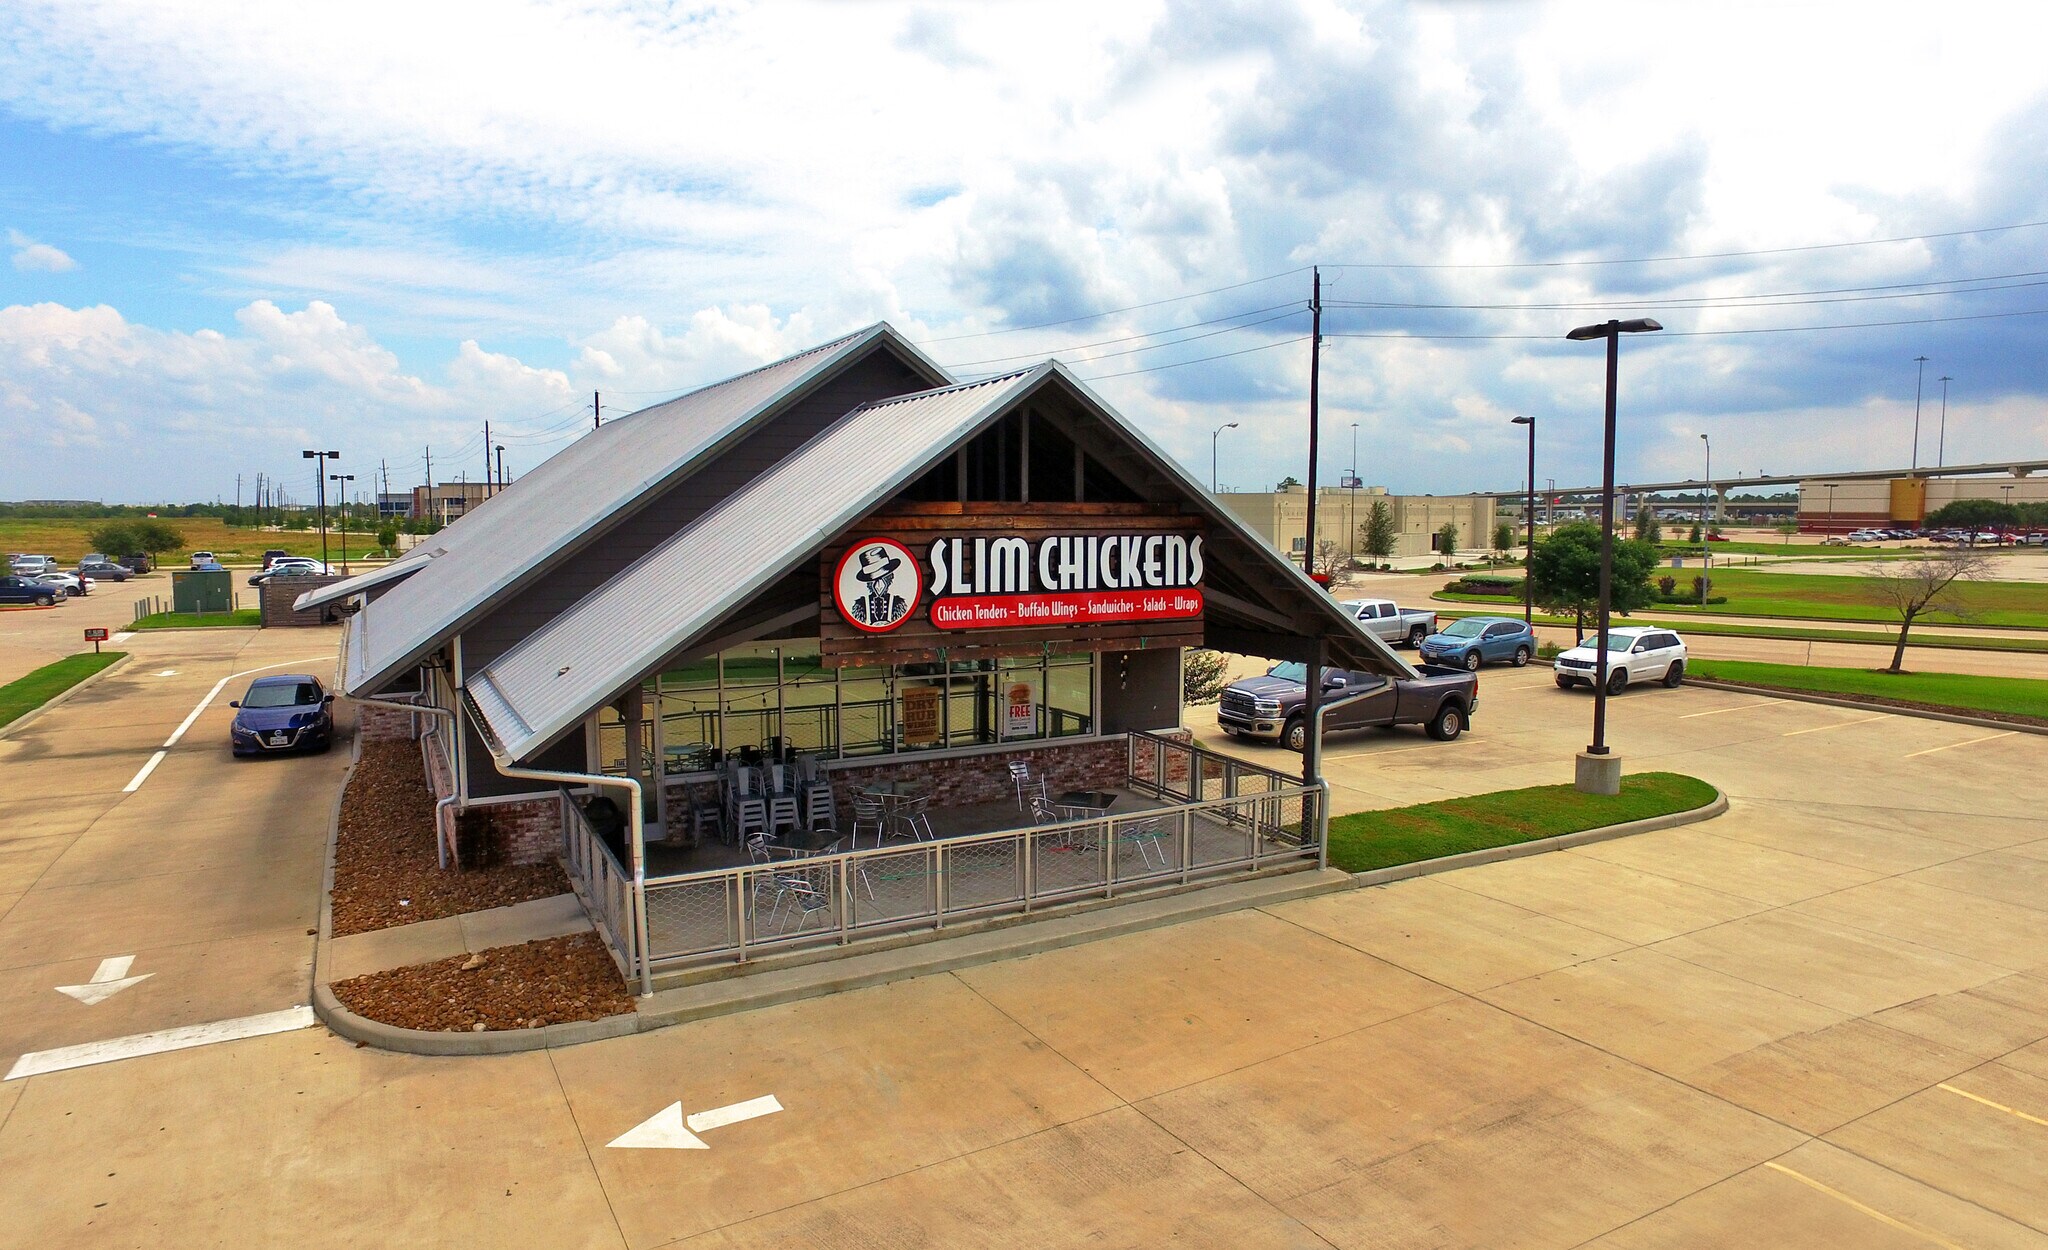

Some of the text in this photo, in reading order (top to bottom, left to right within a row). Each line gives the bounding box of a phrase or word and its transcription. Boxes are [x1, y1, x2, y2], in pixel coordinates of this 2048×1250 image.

[930, 535, 1203, 596] SLIM CHICKENS
[937, 605, 973, 621] Chicken
[974, 604, 1008, 620] Tenders
[1018, 602, 1050, 618] Buffalo
[1051, 600, 1078, 618] Wings
[1088, 598, 1134, 614] Sandwiches
[1143, 597, 1167, 612] Salads
[1174, 596, 1198, 612] Wraps
[905, 699, 936, 711] DRY
[1009, 704, 1031, 718] FREE
[905, 710, 936, 722] RUB
